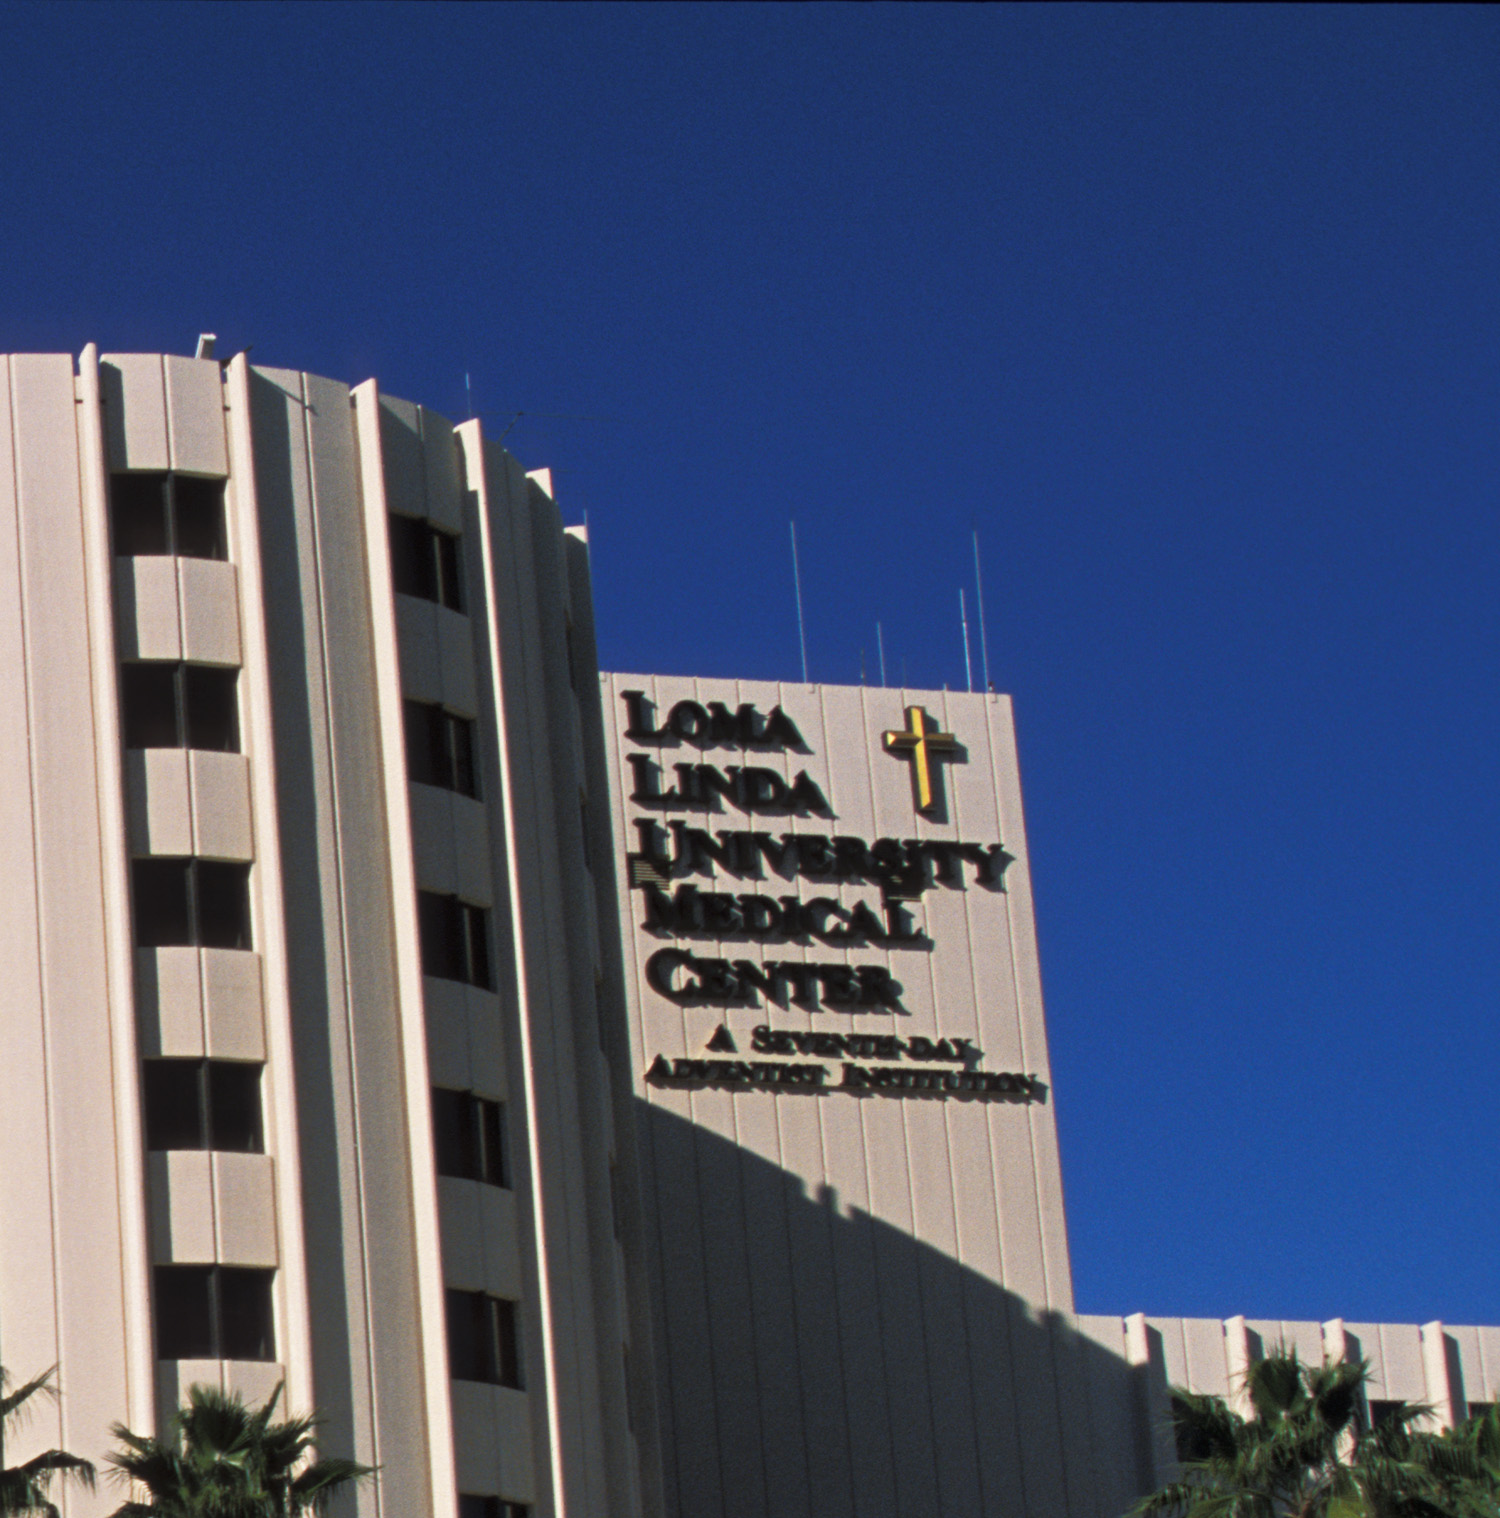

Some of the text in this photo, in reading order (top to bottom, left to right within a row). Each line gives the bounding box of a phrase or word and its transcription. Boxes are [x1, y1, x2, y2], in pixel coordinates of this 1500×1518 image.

[621, 690, 811, 750] LOMA
[626, 753, 833, 817] LINDA
[633, 818, 1011, 889] UNIVERSITY
[641, 884, 930, 949] MEDICAL
[645, 947, 907, 1013] CENTER
[705, 1023, 738, 1053] A
